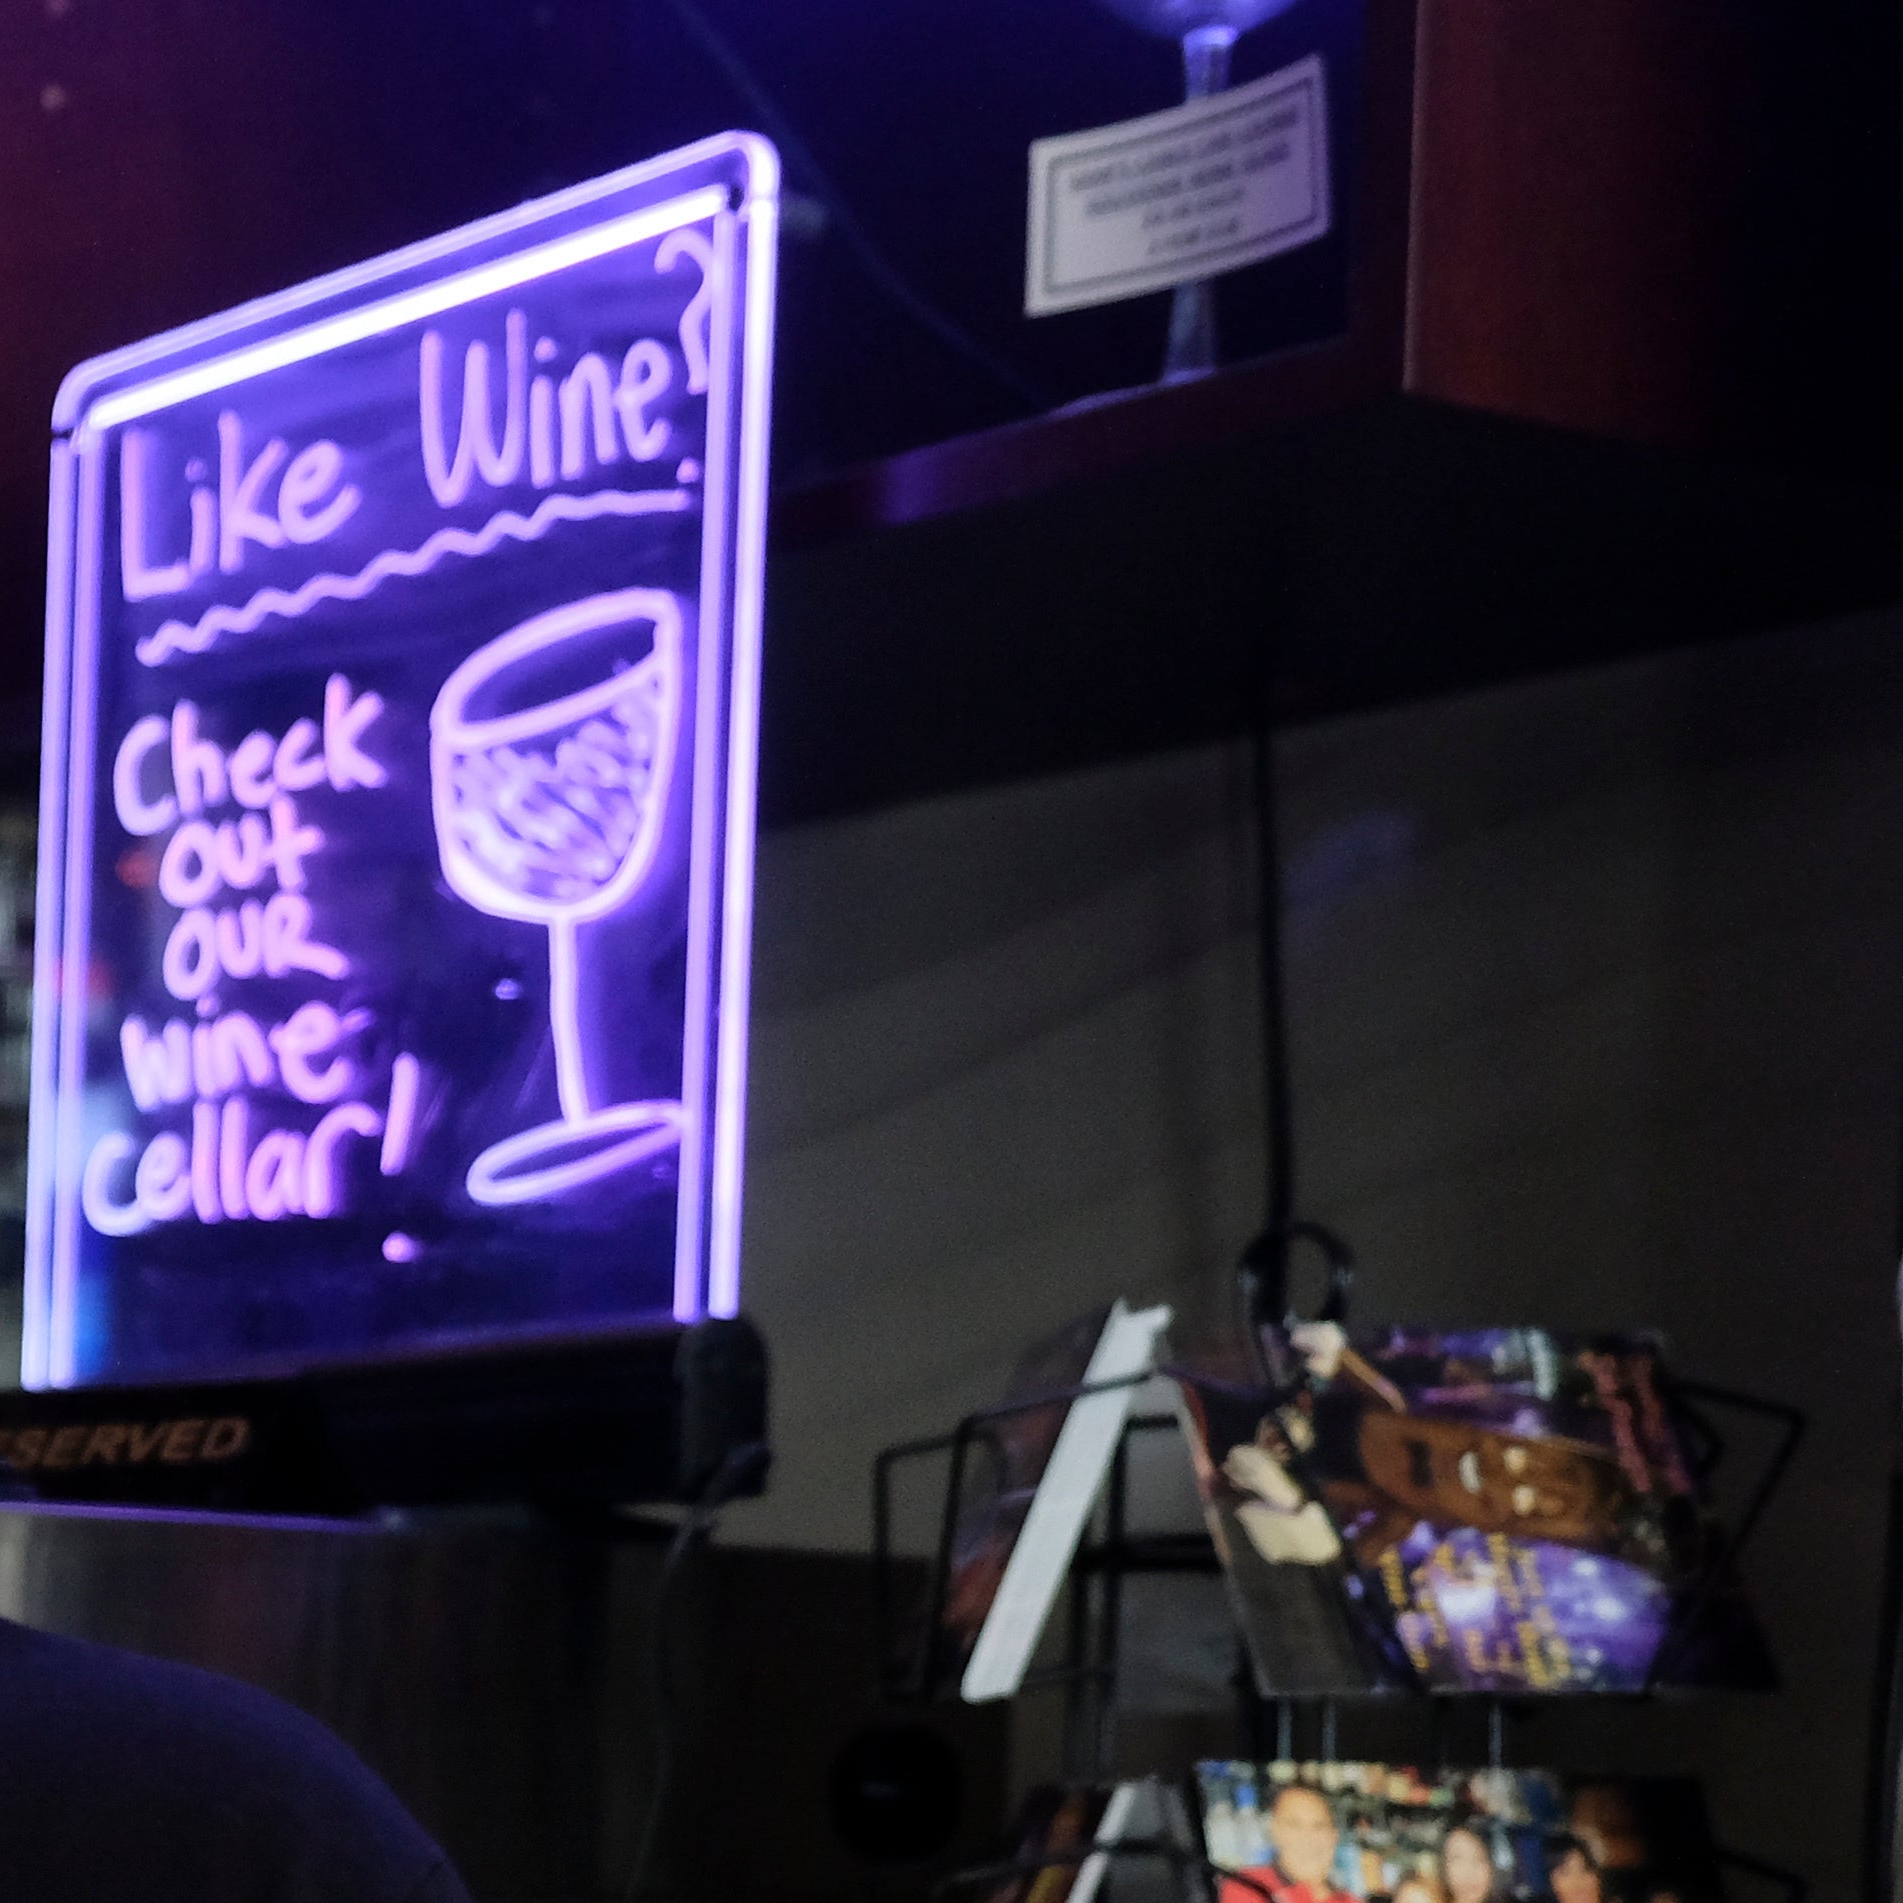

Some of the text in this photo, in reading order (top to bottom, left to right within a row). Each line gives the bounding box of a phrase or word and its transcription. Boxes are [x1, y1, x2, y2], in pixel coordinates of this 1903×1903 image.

[119, 228, 716, 600] Like Wine?
[113, 673, 390, 836] Check
